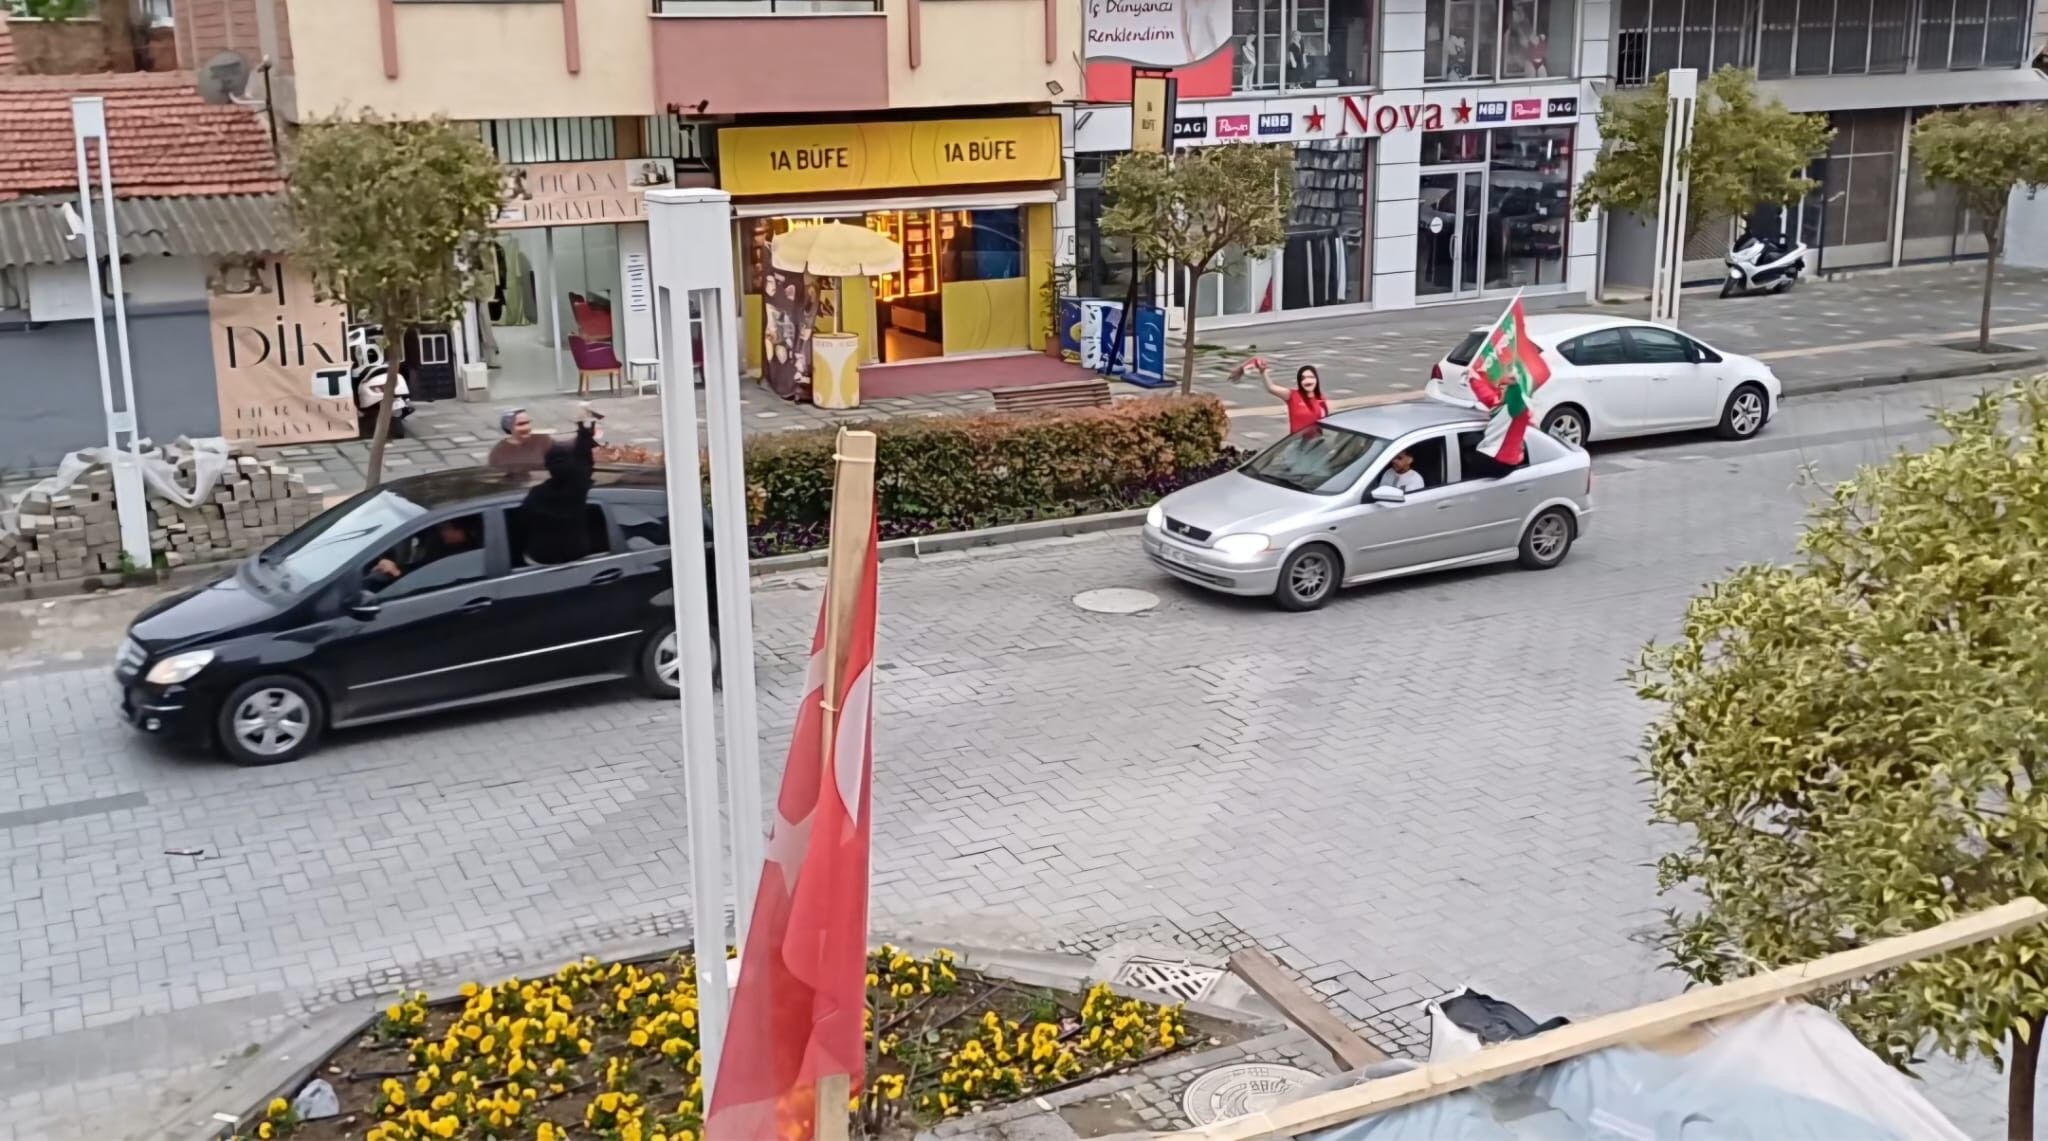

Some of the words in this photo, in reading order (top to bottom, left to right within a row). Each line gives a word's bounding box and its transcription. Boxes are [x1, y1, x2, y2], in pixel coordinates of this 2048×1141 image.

[1336, 95, 1444, 136] Nova
[770, 150, 791, 171] 1A
[796, 144, 849, 170] BÜFE
[944, 142, 964, 163] 1A
[968, 136, 1017, 161] BÜFE
